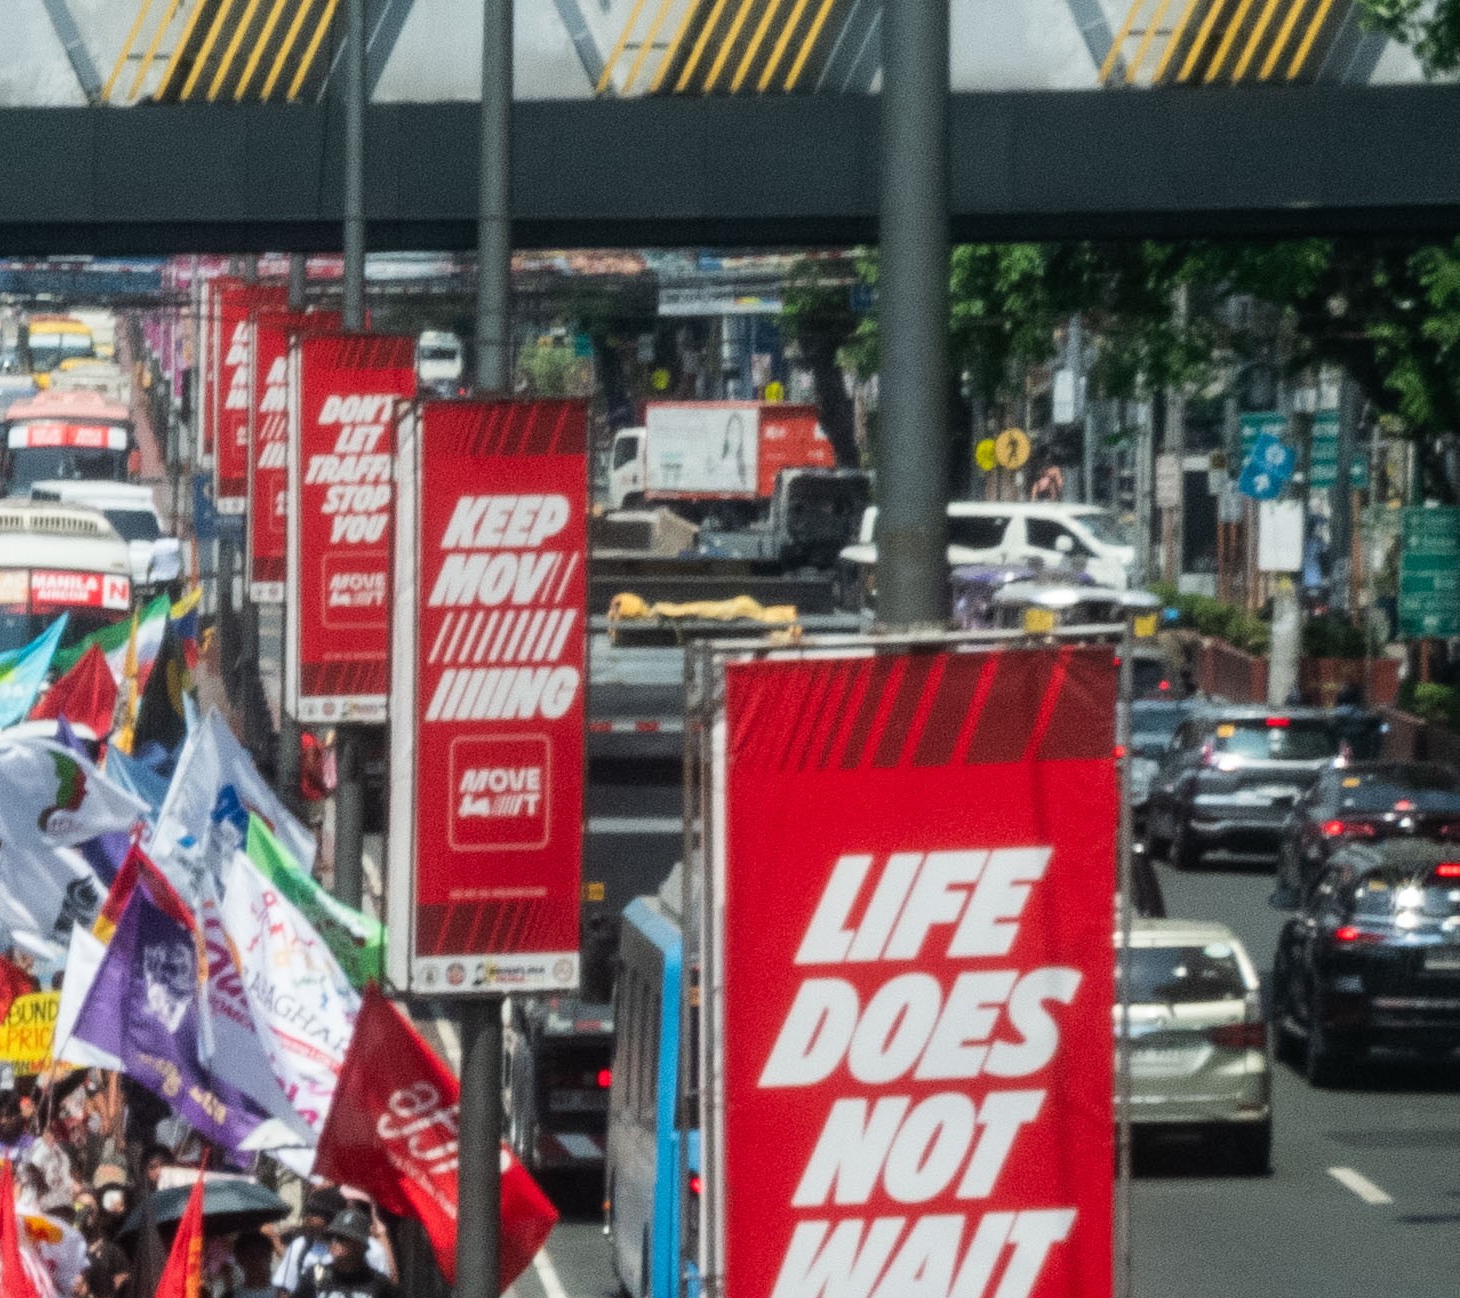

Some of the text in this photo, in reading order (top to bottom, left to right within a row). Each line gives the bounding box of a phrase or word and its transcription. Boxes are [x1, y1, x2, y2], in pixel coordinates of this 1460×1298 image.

[334, 425, 384, 453] LET
[330, 515, 387, 544] YOU
[441, 494, 570, 550] KEEP
[460, 767, 540, 793] MOVE
[793, 847, 1053, 965] LIFE
[757, 967, 1082, 1089] DOES
[790, 1090, 1047, 1208] NOT
